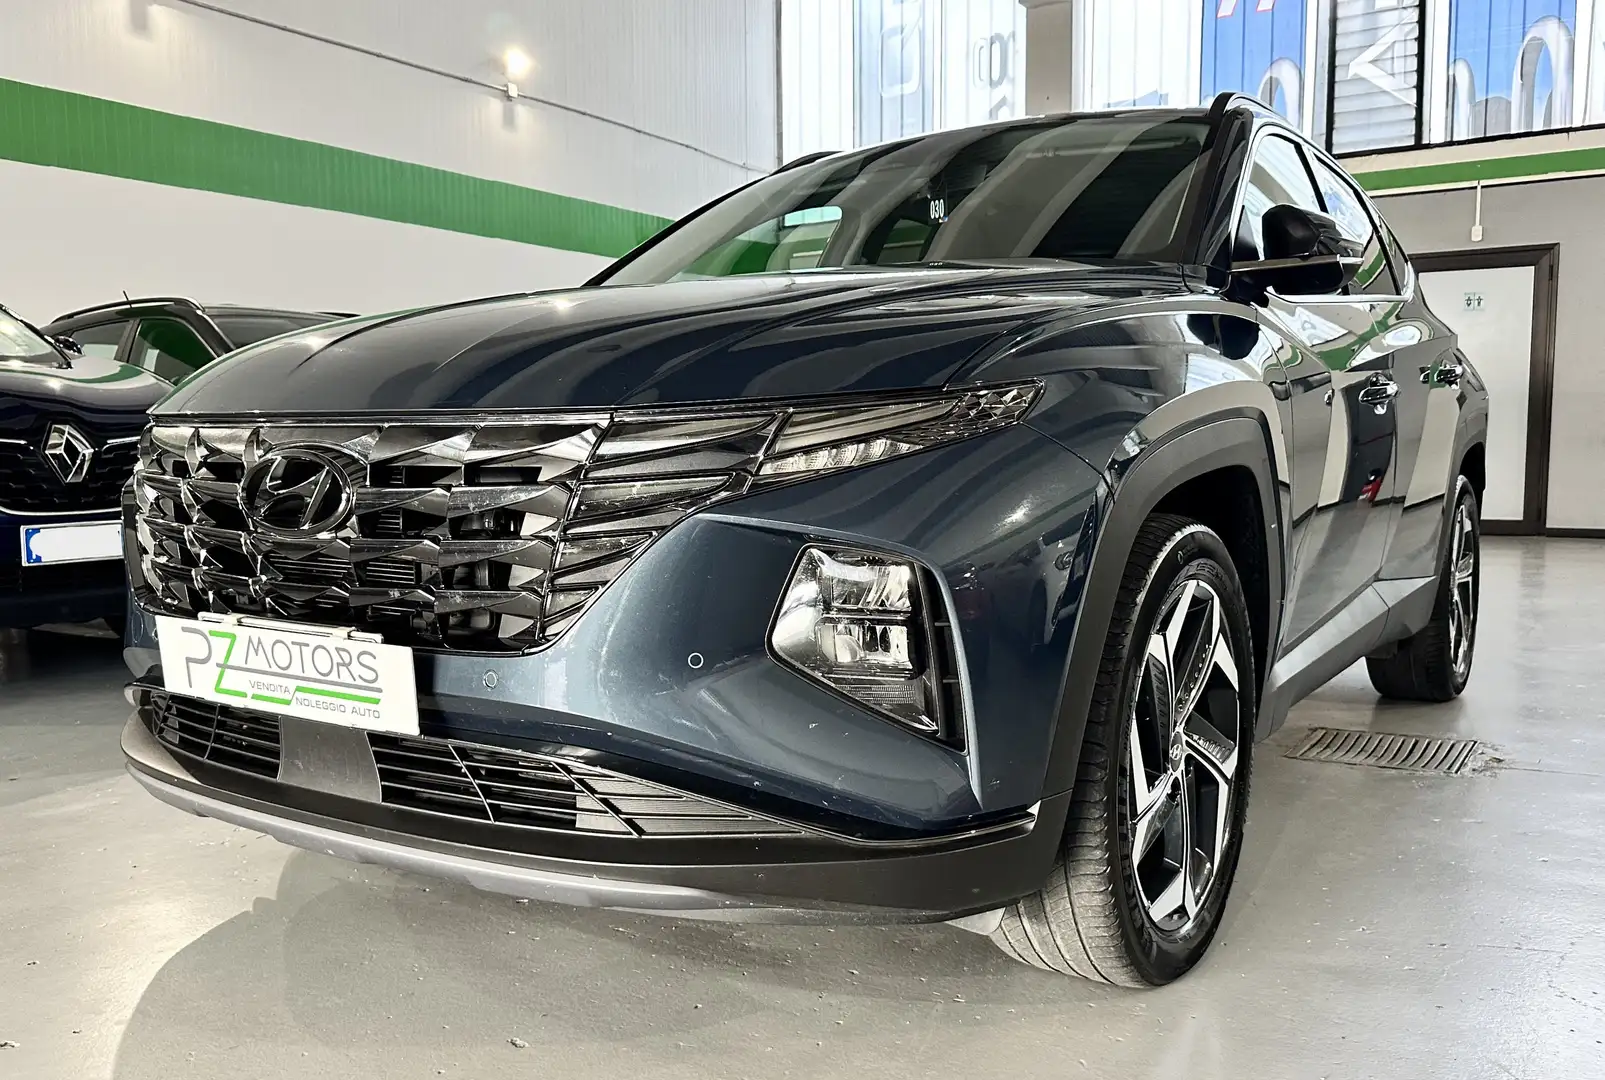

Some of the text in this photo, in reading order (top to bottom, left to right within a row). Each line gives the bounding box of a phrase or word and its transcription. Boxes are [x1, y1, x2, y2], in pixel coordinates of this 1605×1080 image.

[930, 199, 944, 219] 030
[245, 635, 379, 684] MOTORS
[249, 679, 291, 695] VENDITA
[295, 697, 381, 719] NOLEGGIO AUTO
